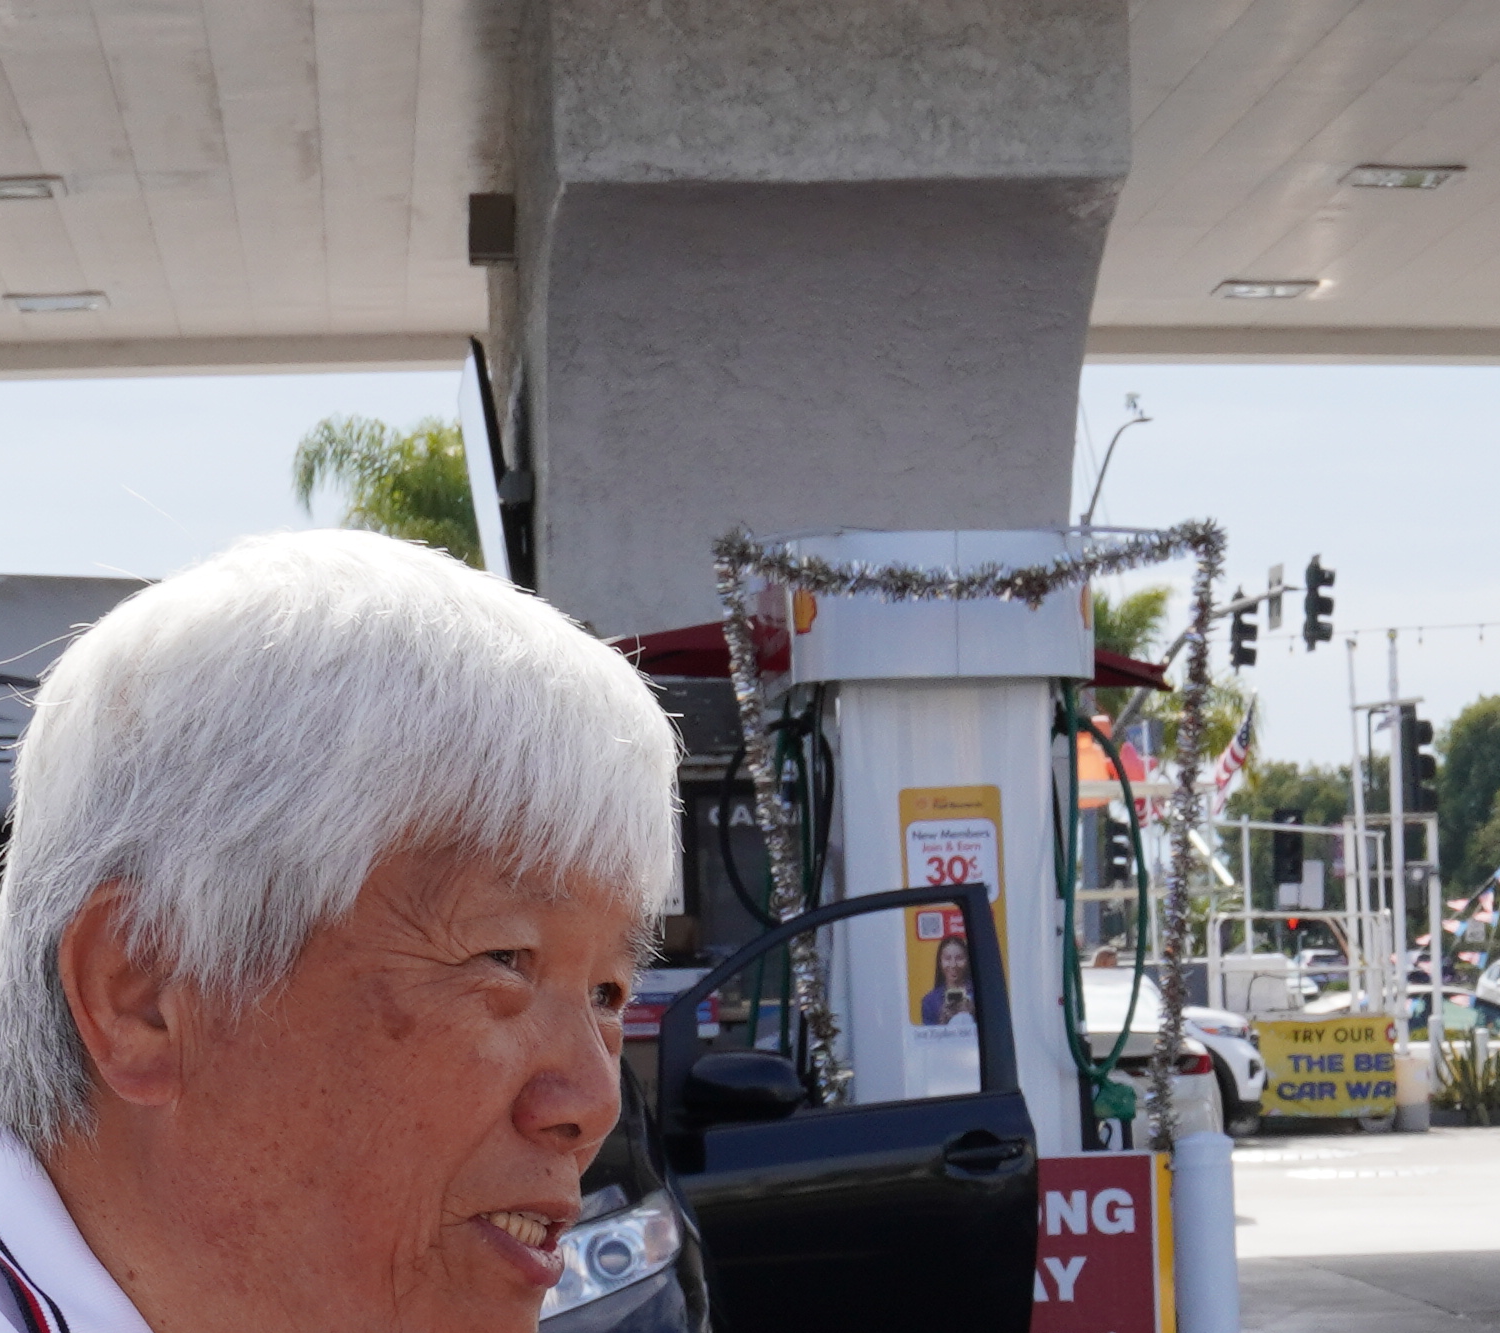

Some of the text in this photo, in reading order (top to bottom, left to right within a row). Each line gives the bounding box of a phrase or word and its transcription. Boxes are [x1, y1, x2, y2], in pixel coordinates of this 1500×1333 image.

[1292, 1028, 1376, 1043] TRY OUR
[1287, 1054, 1344, 1073] THE
[1277, 1081, 1337, 1100] CAR
[1038, 1188, 1135, 1235] NG
